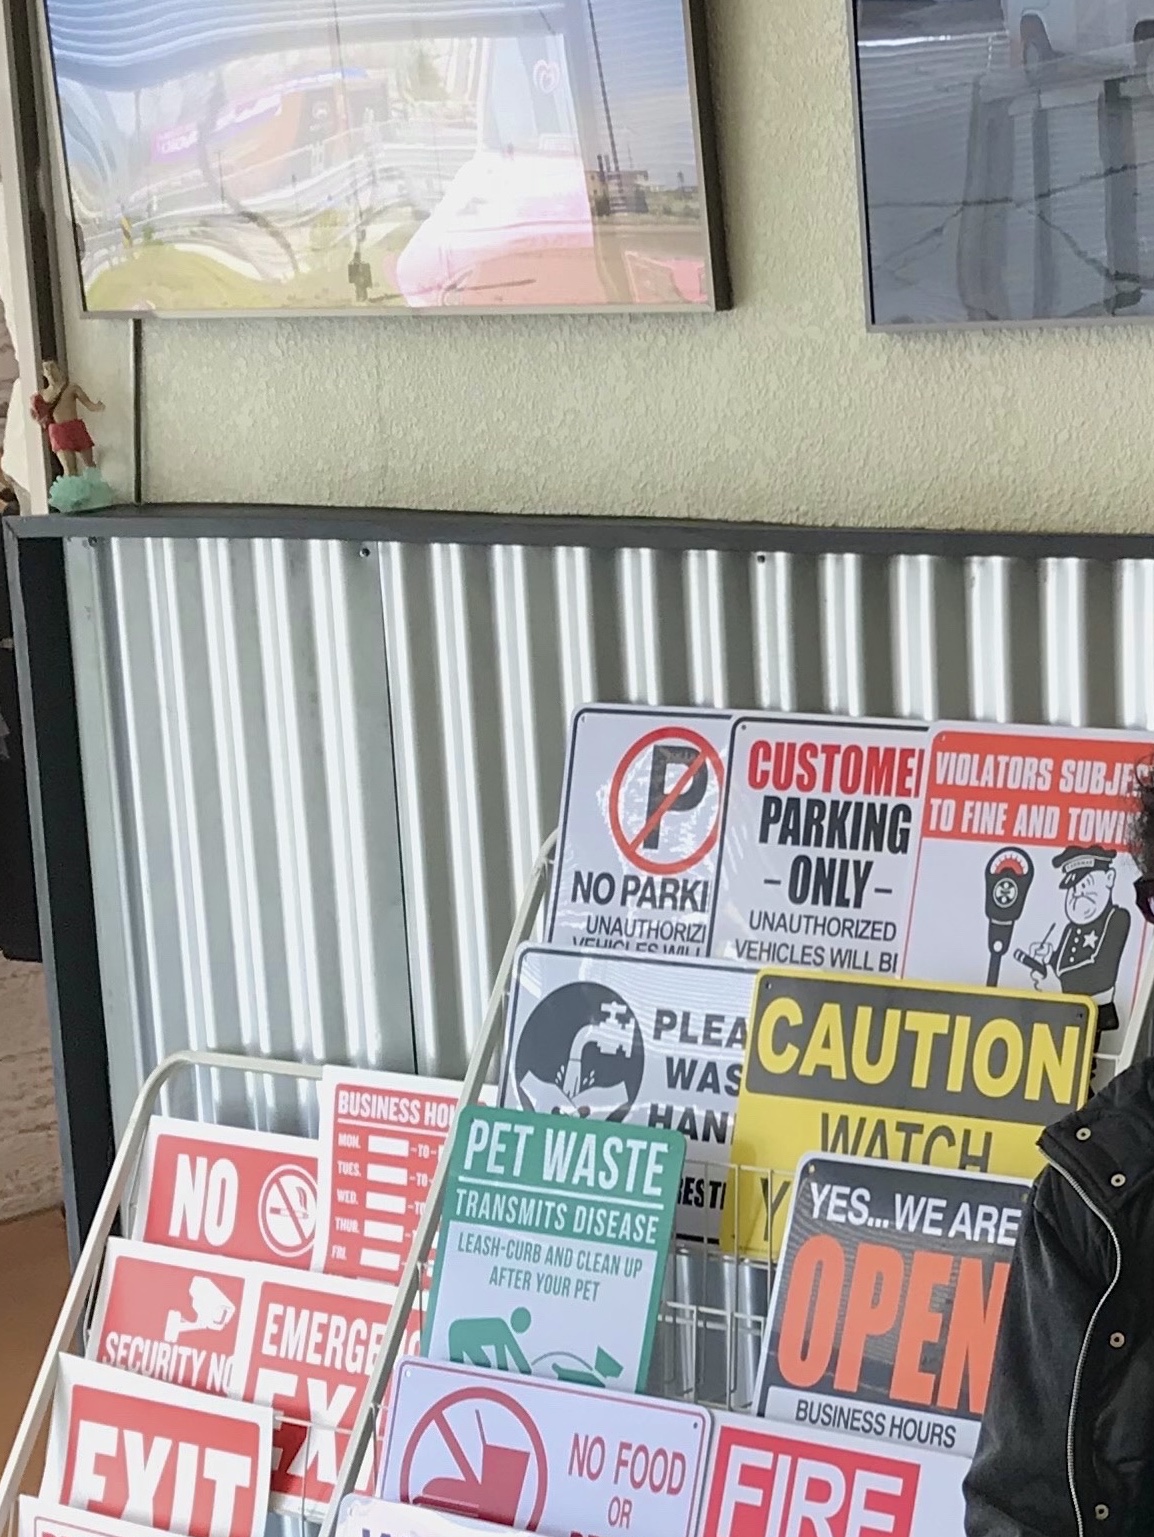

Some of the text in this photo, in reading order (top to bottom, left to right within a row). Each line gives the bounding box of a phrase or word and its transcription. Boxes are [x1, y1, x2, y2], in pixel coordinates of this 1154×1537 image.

[747, 740, 925, 798] CUSTOME
[936, 752, 1053, 791] VIOLATORS
[759, 795, 912, 854] PARKING
[929, 797, 955, 832] TO
[961, 800, 1008, 835] FINE
[1012, 803, 1060, 839] AND
[571, 870, 616, 906] NO
[586, 915, 706, 944] UNAUTHORIZ
[749, 910, 897, 942] UNAUTHORIZED
[735, 938, 825, 967] VEHICLES
[830, 946, 874, 971] WILL
[652, 1008, 748, 1049] PLEA
[757, 997, 1080, 1105] CAUTION
[338, 1090, 421, 1125] BUSINESS
[648, 1103, 737, 1145] HAN
[463, 1118, 668, 1197] PET WASTE
[821, 1112, 993, 1174] WATCH
[168, 1153, 239, 1247] NO
[456, 1188, 660, 1245] TRANSMITS DISEASE
[894, 1193, 947, 1237] WE
[948, 1202, 1022, 1247] ARE
[458, 1231, 643, 1279] LEASH-CURB AND CLEAN UP
[489, 1266, 601, 1302] AFTER YOUR PET
[778, 1233, 1011, 1415] OPEN
[103, 1331, 202, 1390] SECURITY
[795, 1399, 956, 1449] BUSINESS HOURS
[568, 1432, 686, 1496] NO FOOD
[608, 1495, 633, 1529] OR
